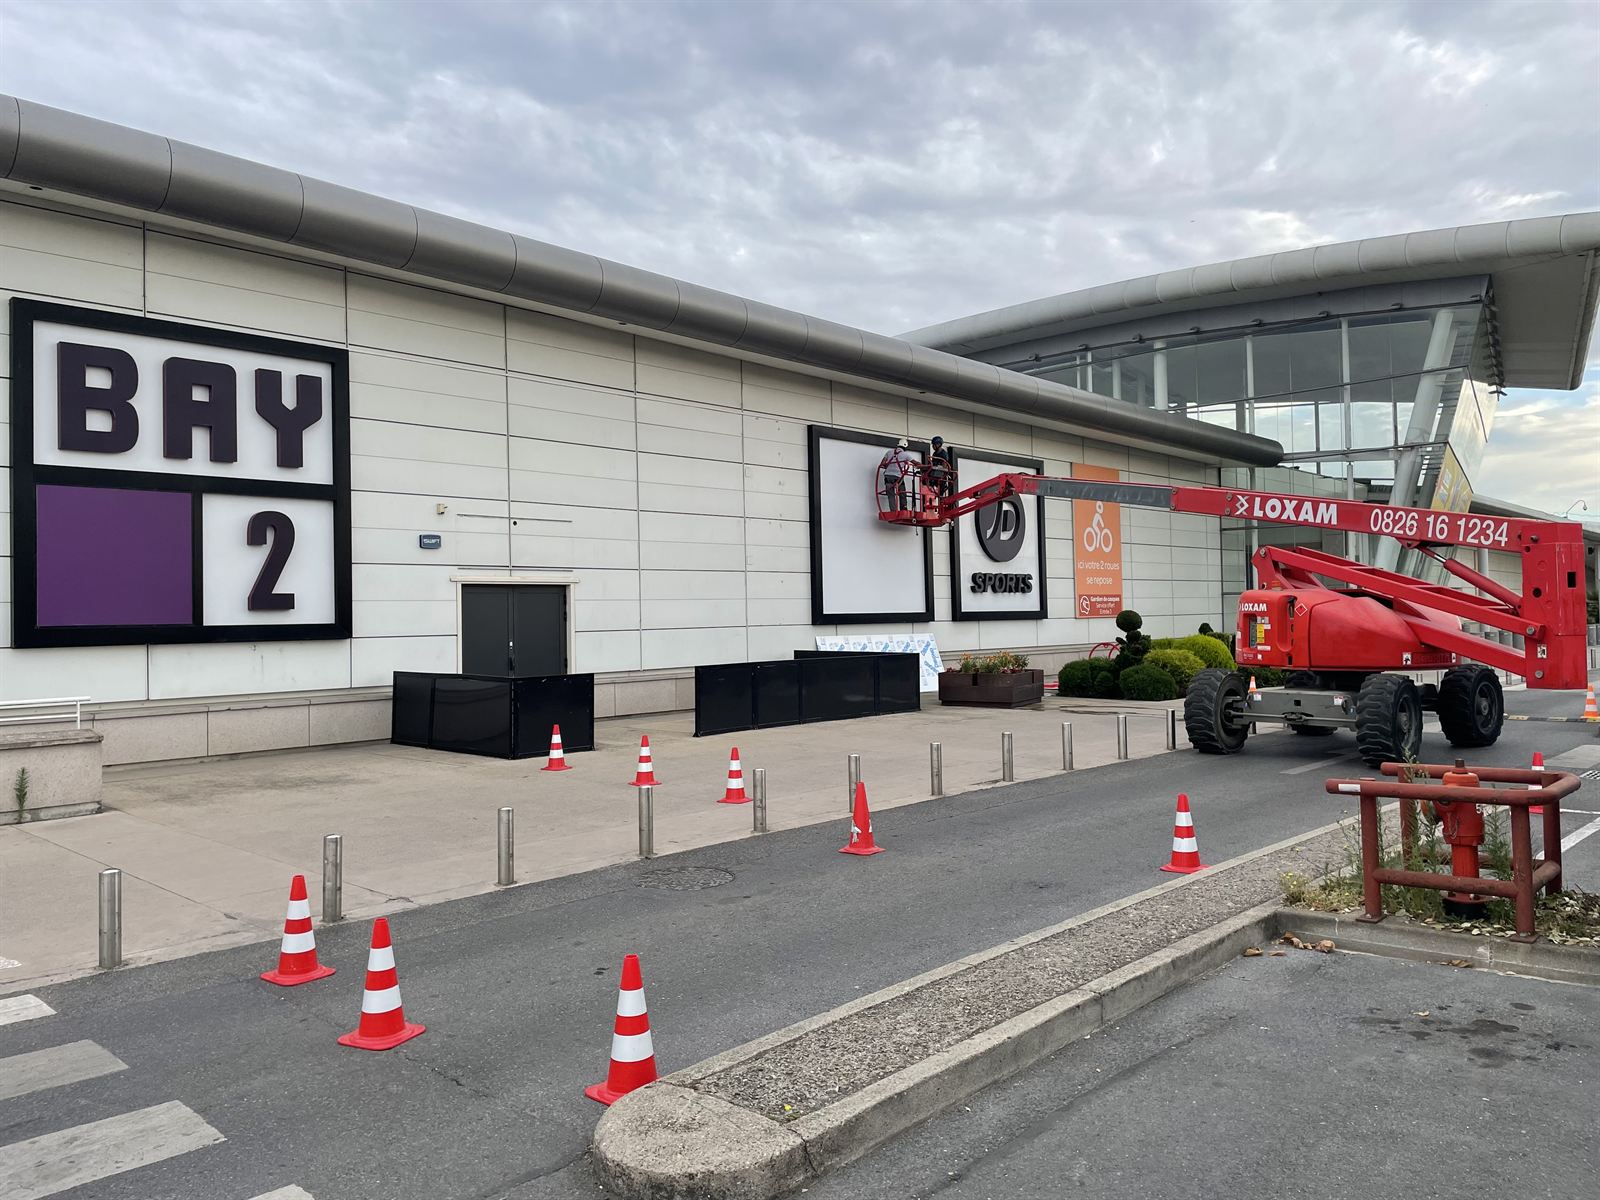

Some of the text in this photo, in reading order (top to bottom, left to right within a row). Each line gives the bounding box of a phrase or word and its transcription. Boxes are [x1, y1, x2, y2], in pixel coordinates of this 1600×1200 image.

[57, 341, 323, 468] BAY
[1253, 497, 1509, 547] LOXAM 0826 16 1234
[247, 510, 296, 611] 2
[1085, 561, 1100, 570] votre
[1100, 560, 1105, 570] 2
[1105, 561, 1120, 570] roues
[970, 572, 1033, 593] SPORTS
[1086, 577, 1113, 587] se repose
[1241, 602, 1267, 612] LOXAM
